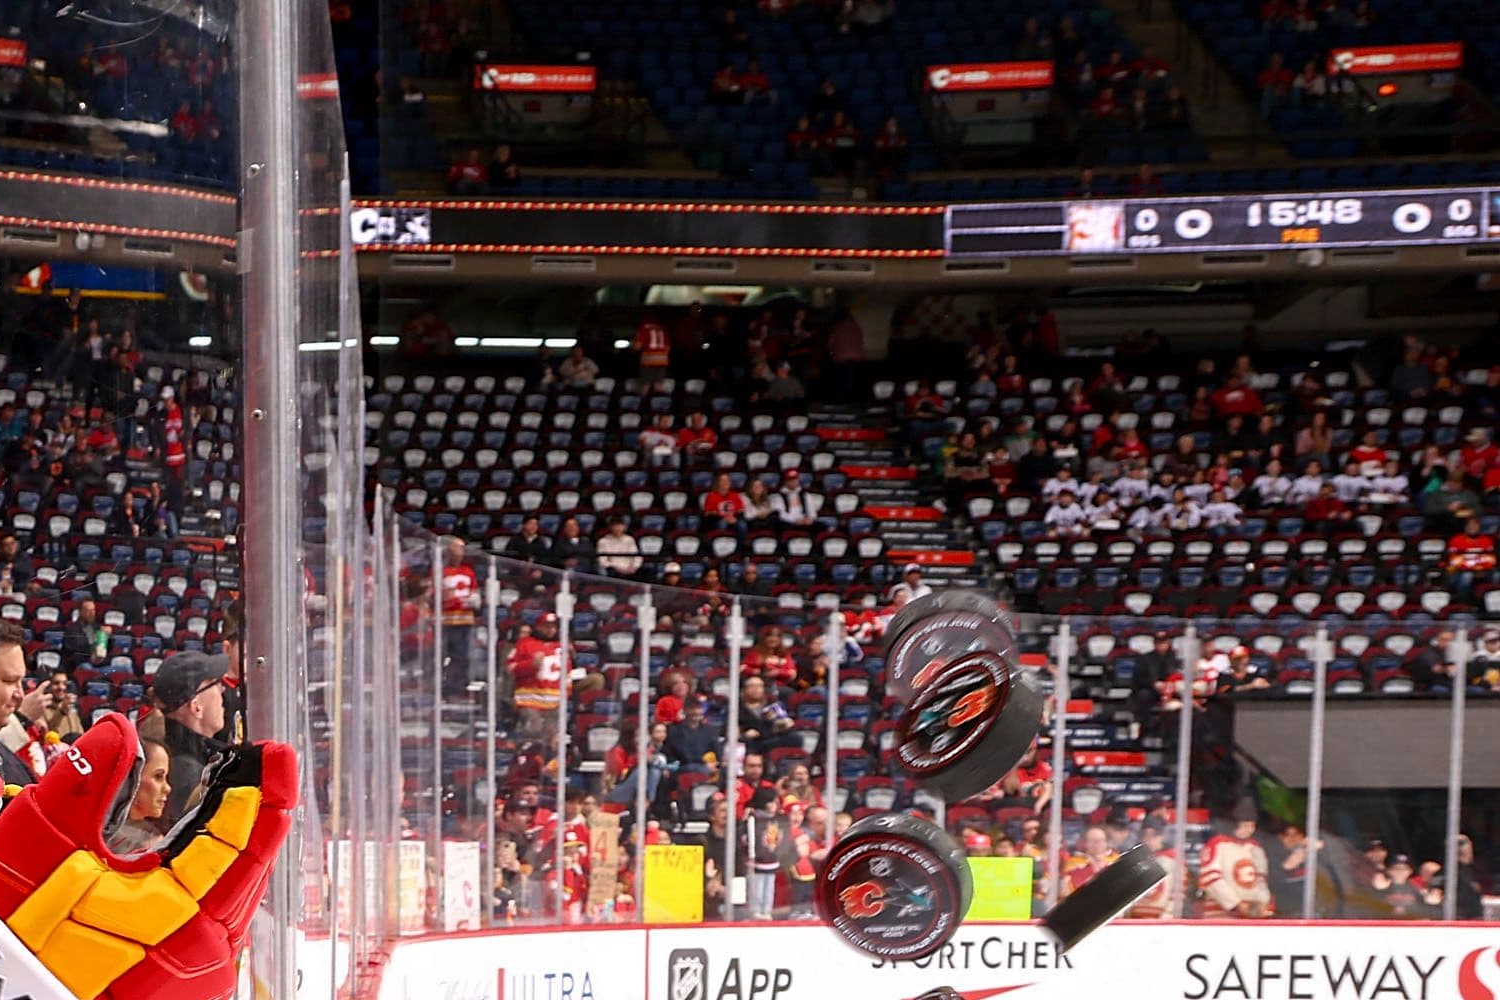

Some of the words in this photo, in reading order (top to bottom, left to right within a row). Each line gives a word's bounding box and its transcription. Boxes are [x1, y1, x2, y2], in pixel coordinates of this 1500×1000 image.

[1134, 208, 1159, 232] 0
[1174, 208, 1213, 240] 0
[1246, 199, 1363, 227] 15:48
[1392, 202, 1432, 234] 0
[1447, 198, 1472, 222] 0
[1183, 953, 1446, 1000] SAFEWAY
